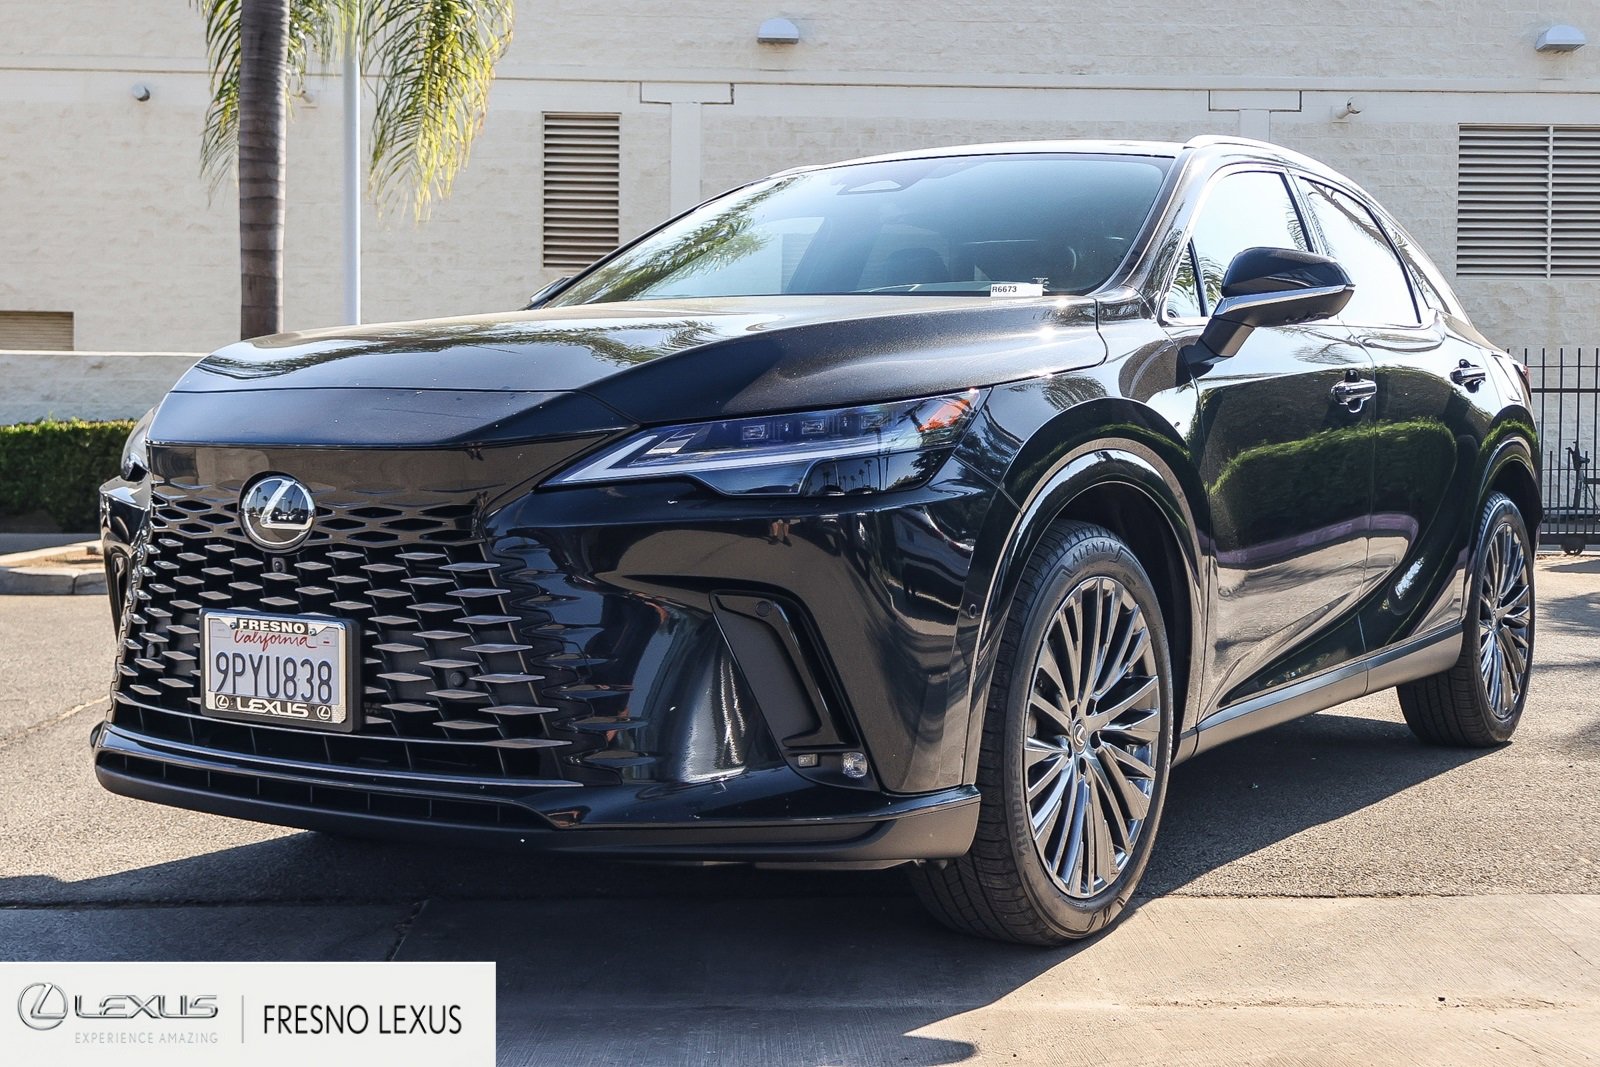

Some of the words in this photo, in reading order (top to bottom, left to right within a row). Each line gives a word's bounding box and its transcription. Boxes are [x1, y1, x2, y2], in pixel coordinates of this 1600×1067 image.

[991, 285, 1017, 293] R6673
[1069, 541, 1114, 567] ALENZA
[238, 619, 306, 635] FRESNO
[234, 630, 318, 652] California
[215, 651, 333, 705] 9PYU838
[236, 697, 310, 719] LEXUS
